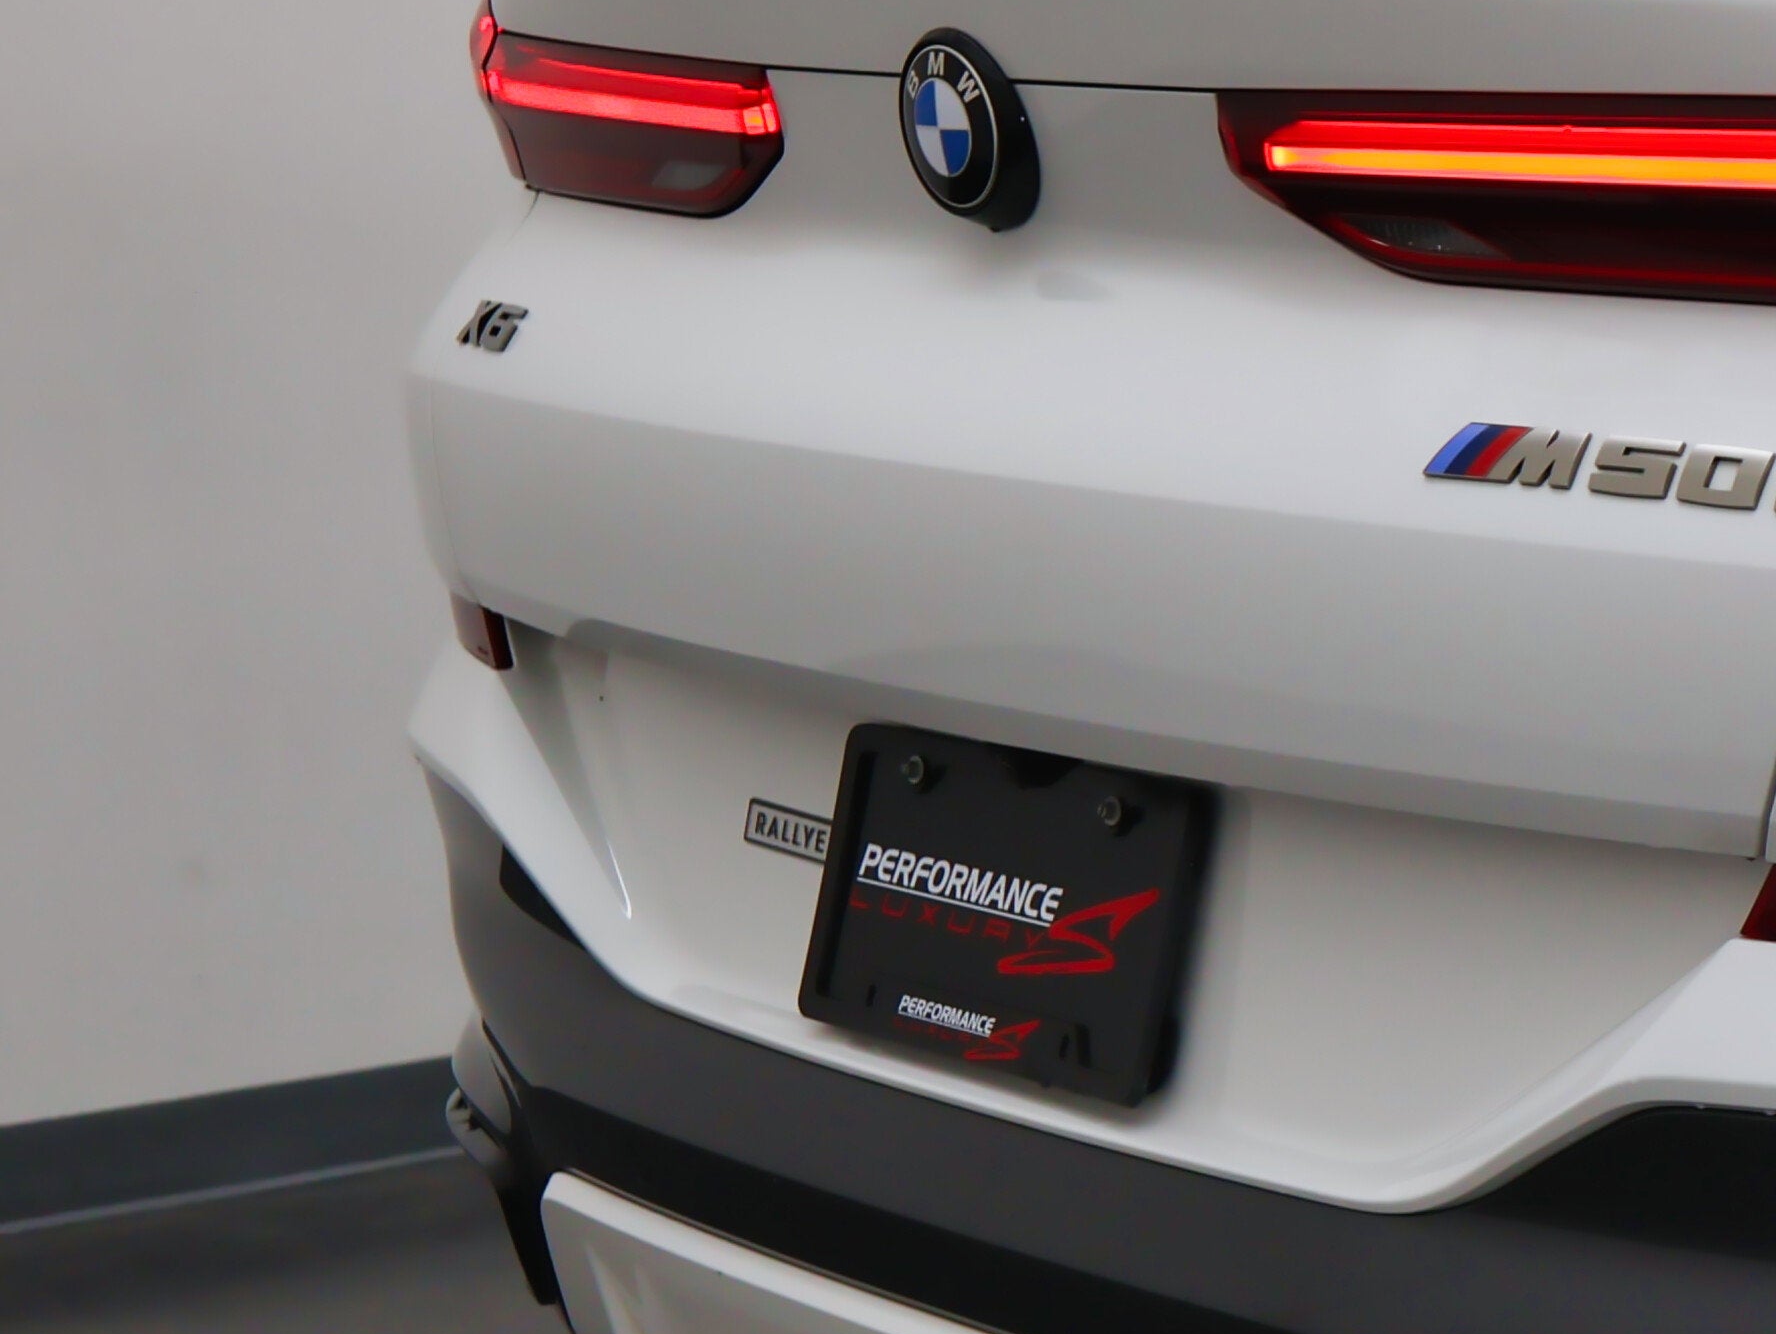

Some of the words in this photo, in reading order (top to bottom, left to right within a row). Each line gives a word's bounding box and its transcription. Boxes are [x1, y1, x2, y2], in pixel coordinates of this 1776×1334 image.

[908, 51, 980, 103] BMW
[456, 299, 529, 353] X6
[754, 811, 827, 854] RALLYE
[858, 842, 1063, 922] PERFORMANCE
[899, 994, 997, 1035] PERFORMANCE
